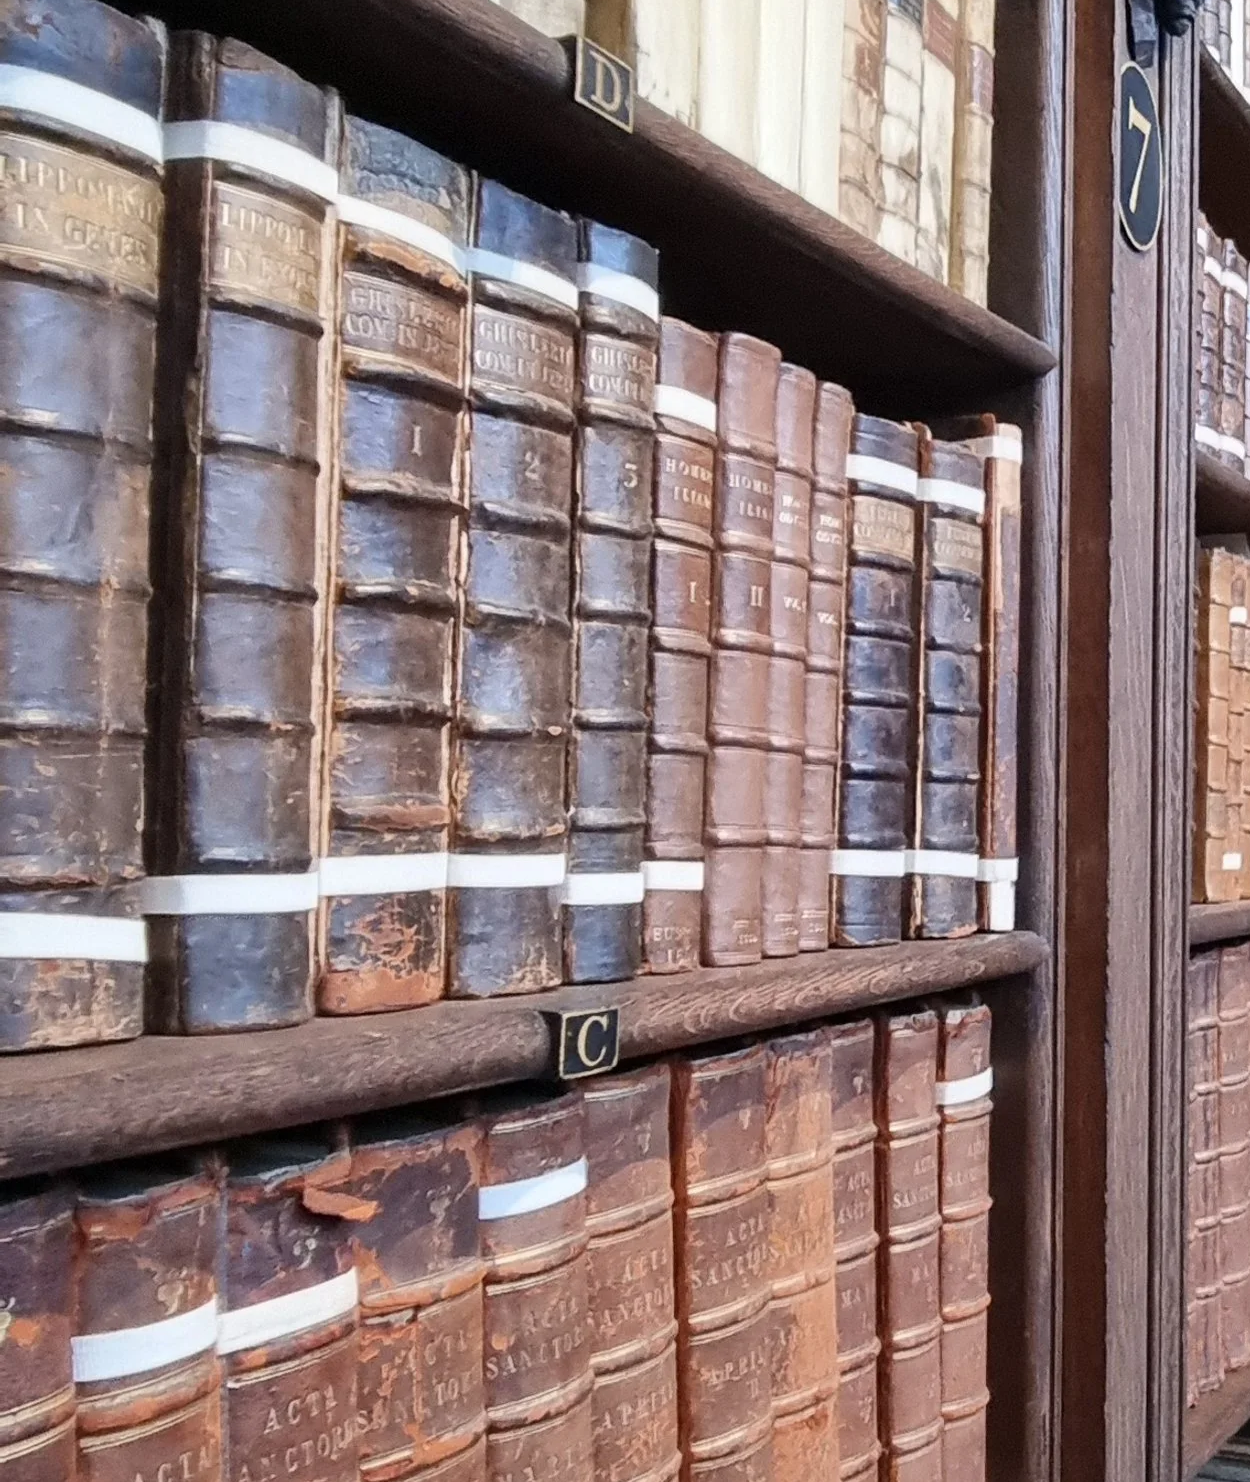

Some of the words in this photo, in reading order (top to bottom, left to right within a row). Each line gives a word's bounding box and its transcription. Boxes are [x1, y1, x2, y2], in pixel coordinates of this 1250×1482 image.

[589, 49, 621, 113] D
[1128, 95, 1152, 214] 7
[525, 451, 540, 480] 2
[624, 462, 639, 488] 3
[750, 585, 765, 607] II
[577, 1014, 609, 1067] C
